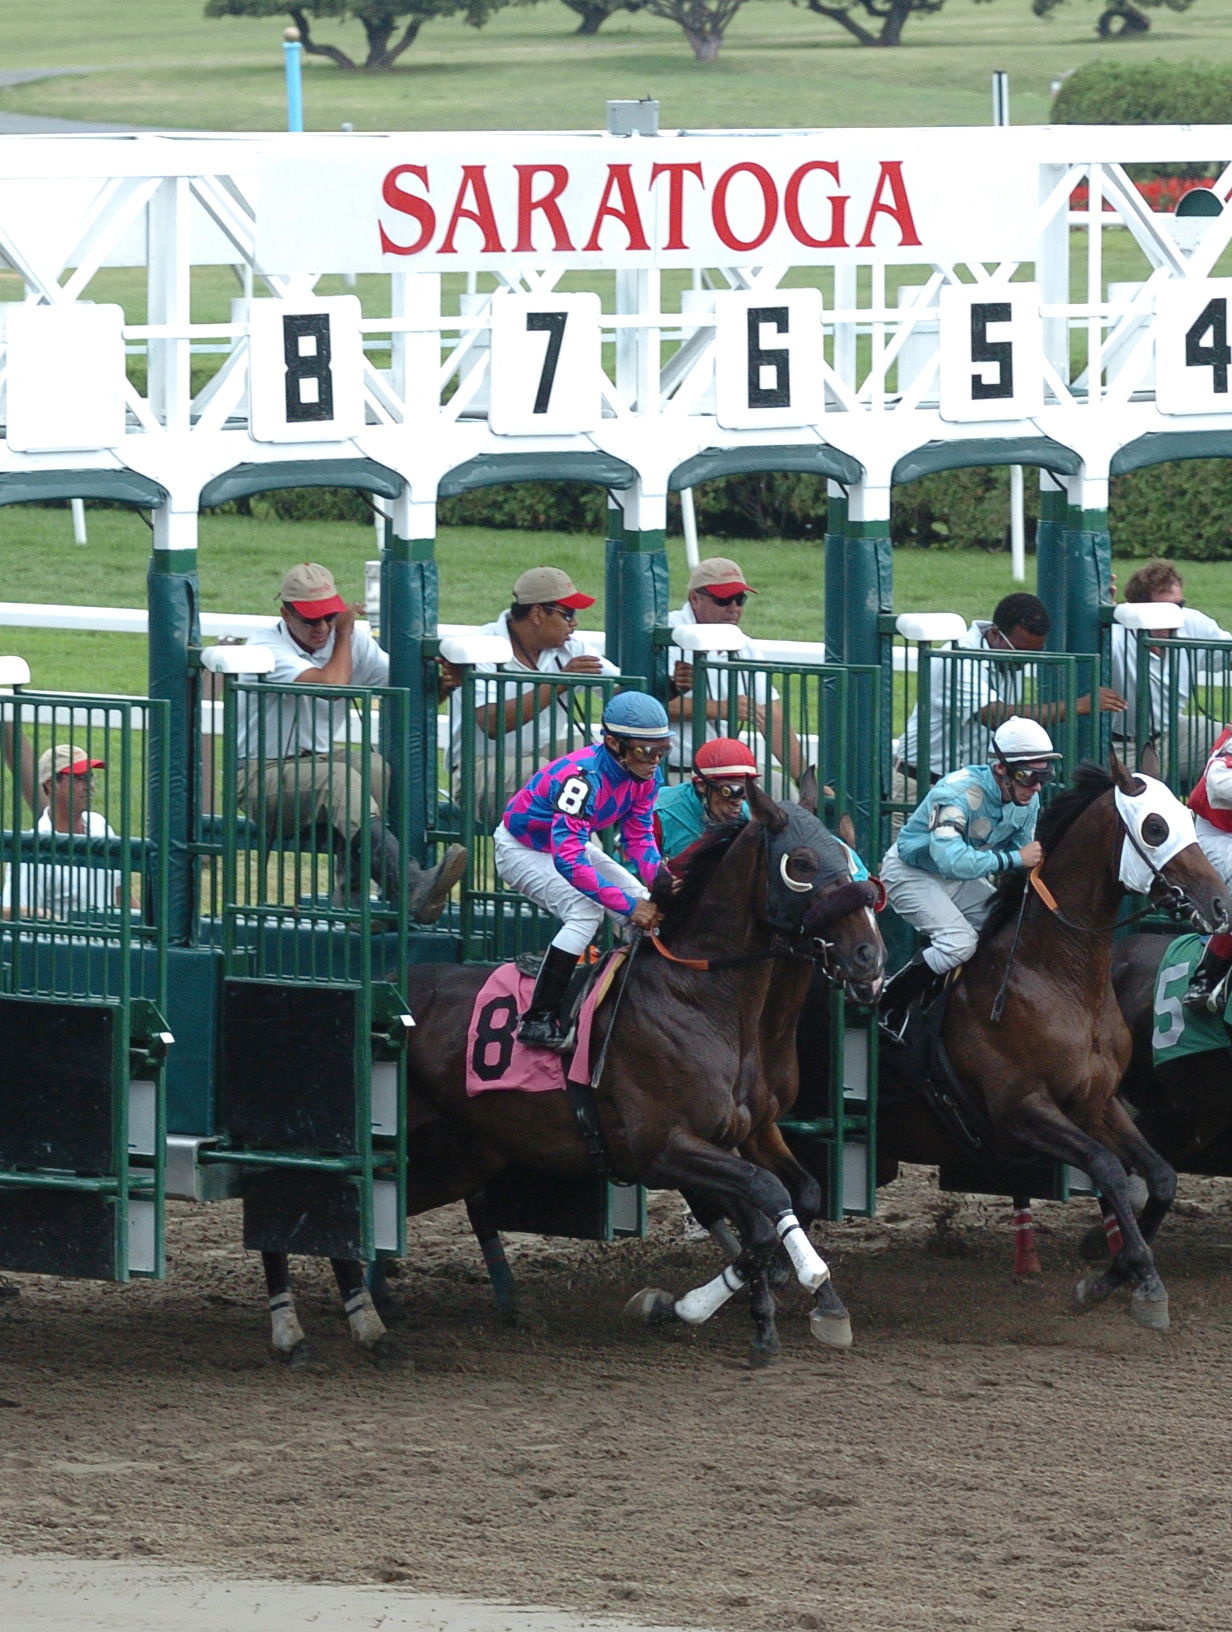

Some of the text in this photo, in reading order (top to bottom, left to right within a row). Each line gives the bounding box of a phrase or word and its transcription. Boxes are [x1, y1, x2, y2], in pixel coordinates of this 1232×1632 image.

[378, 161, 922, 255] SARATOGA
[283, 313, 334, 422] 8
[526, 312, 568, 414] 7
[747, 307, 791, 408] 6
[971, 302, 1013, 400] 5
[1185, 298, 1232, 394] 4
[558, 777, 589, 815] 8
[472, 994, 518, 1081] 8
[1152, 961, 1190, 1049] 5
